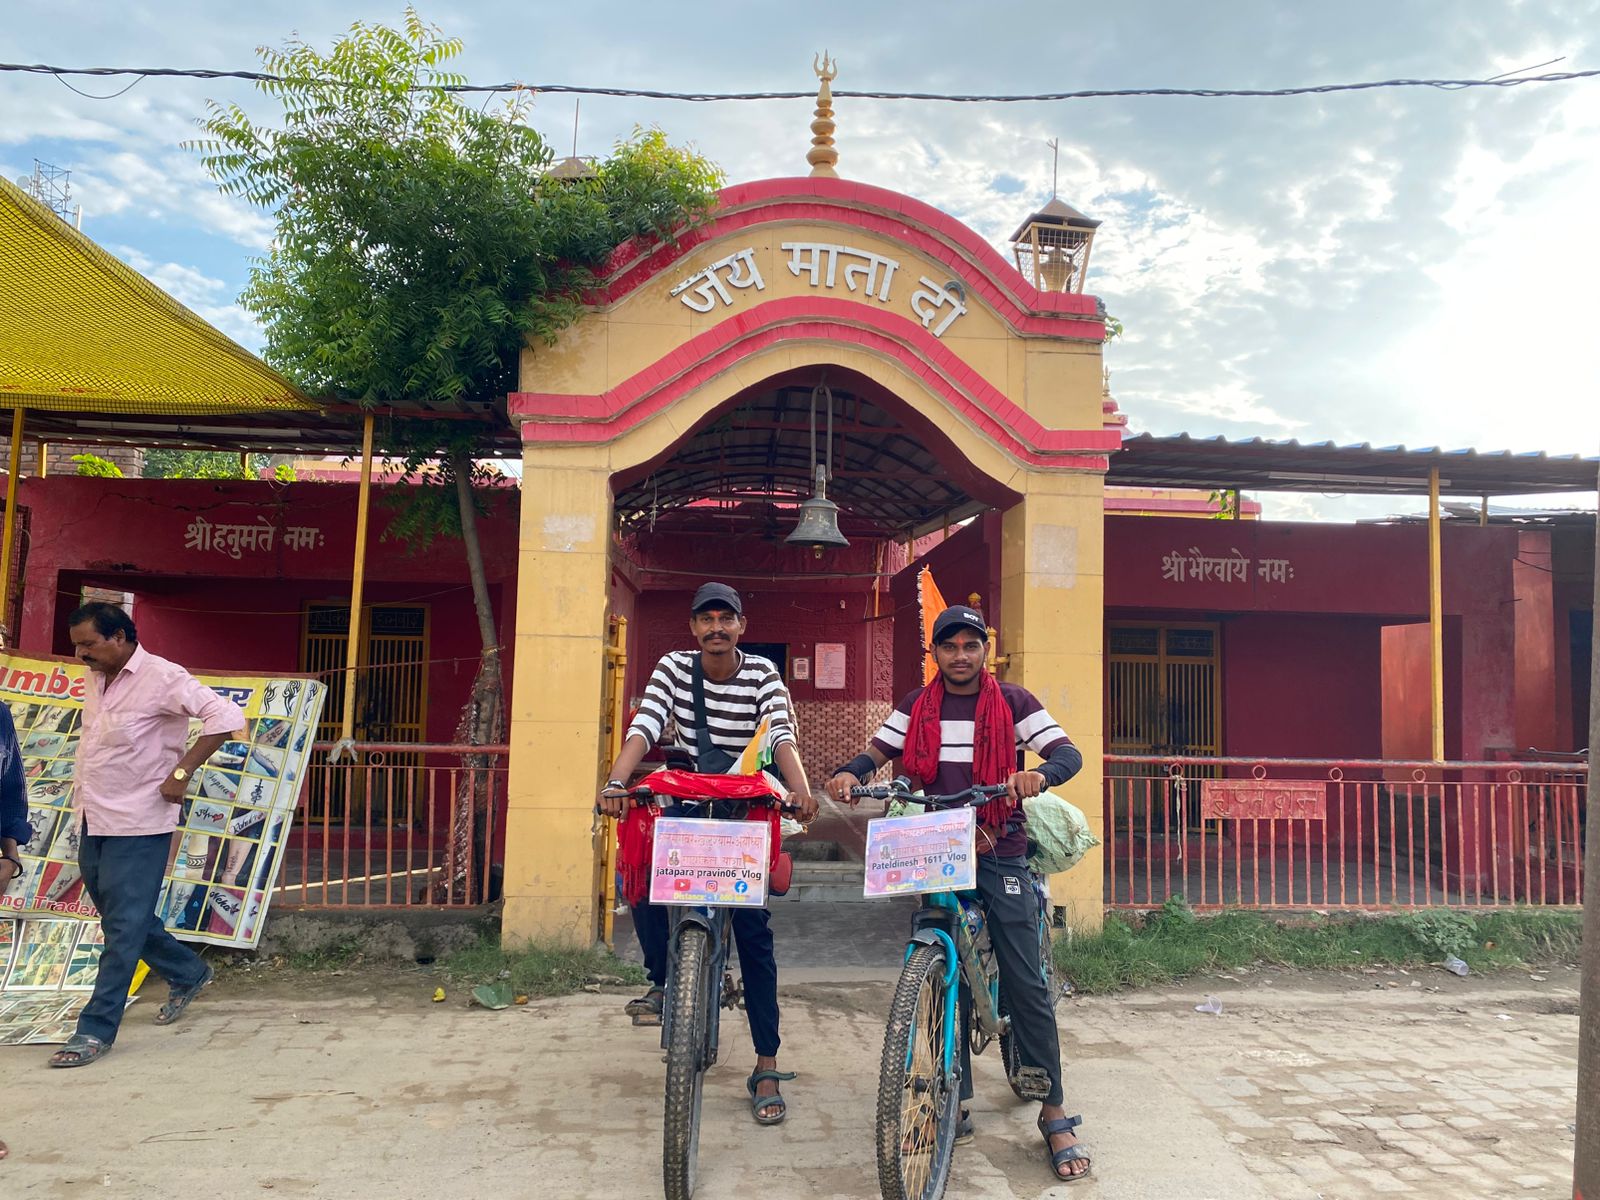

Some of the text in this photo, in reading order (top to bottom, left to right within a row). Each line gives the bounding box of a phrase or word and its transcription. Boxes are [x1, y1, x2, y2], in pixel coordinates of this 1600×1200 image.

[670, 242, 968, 338] जय माता दी
[283, 526, 325, 552] नमः
[1257, 558, 1295, 584] नमः
[656, 867, 695, 878] jatapara
